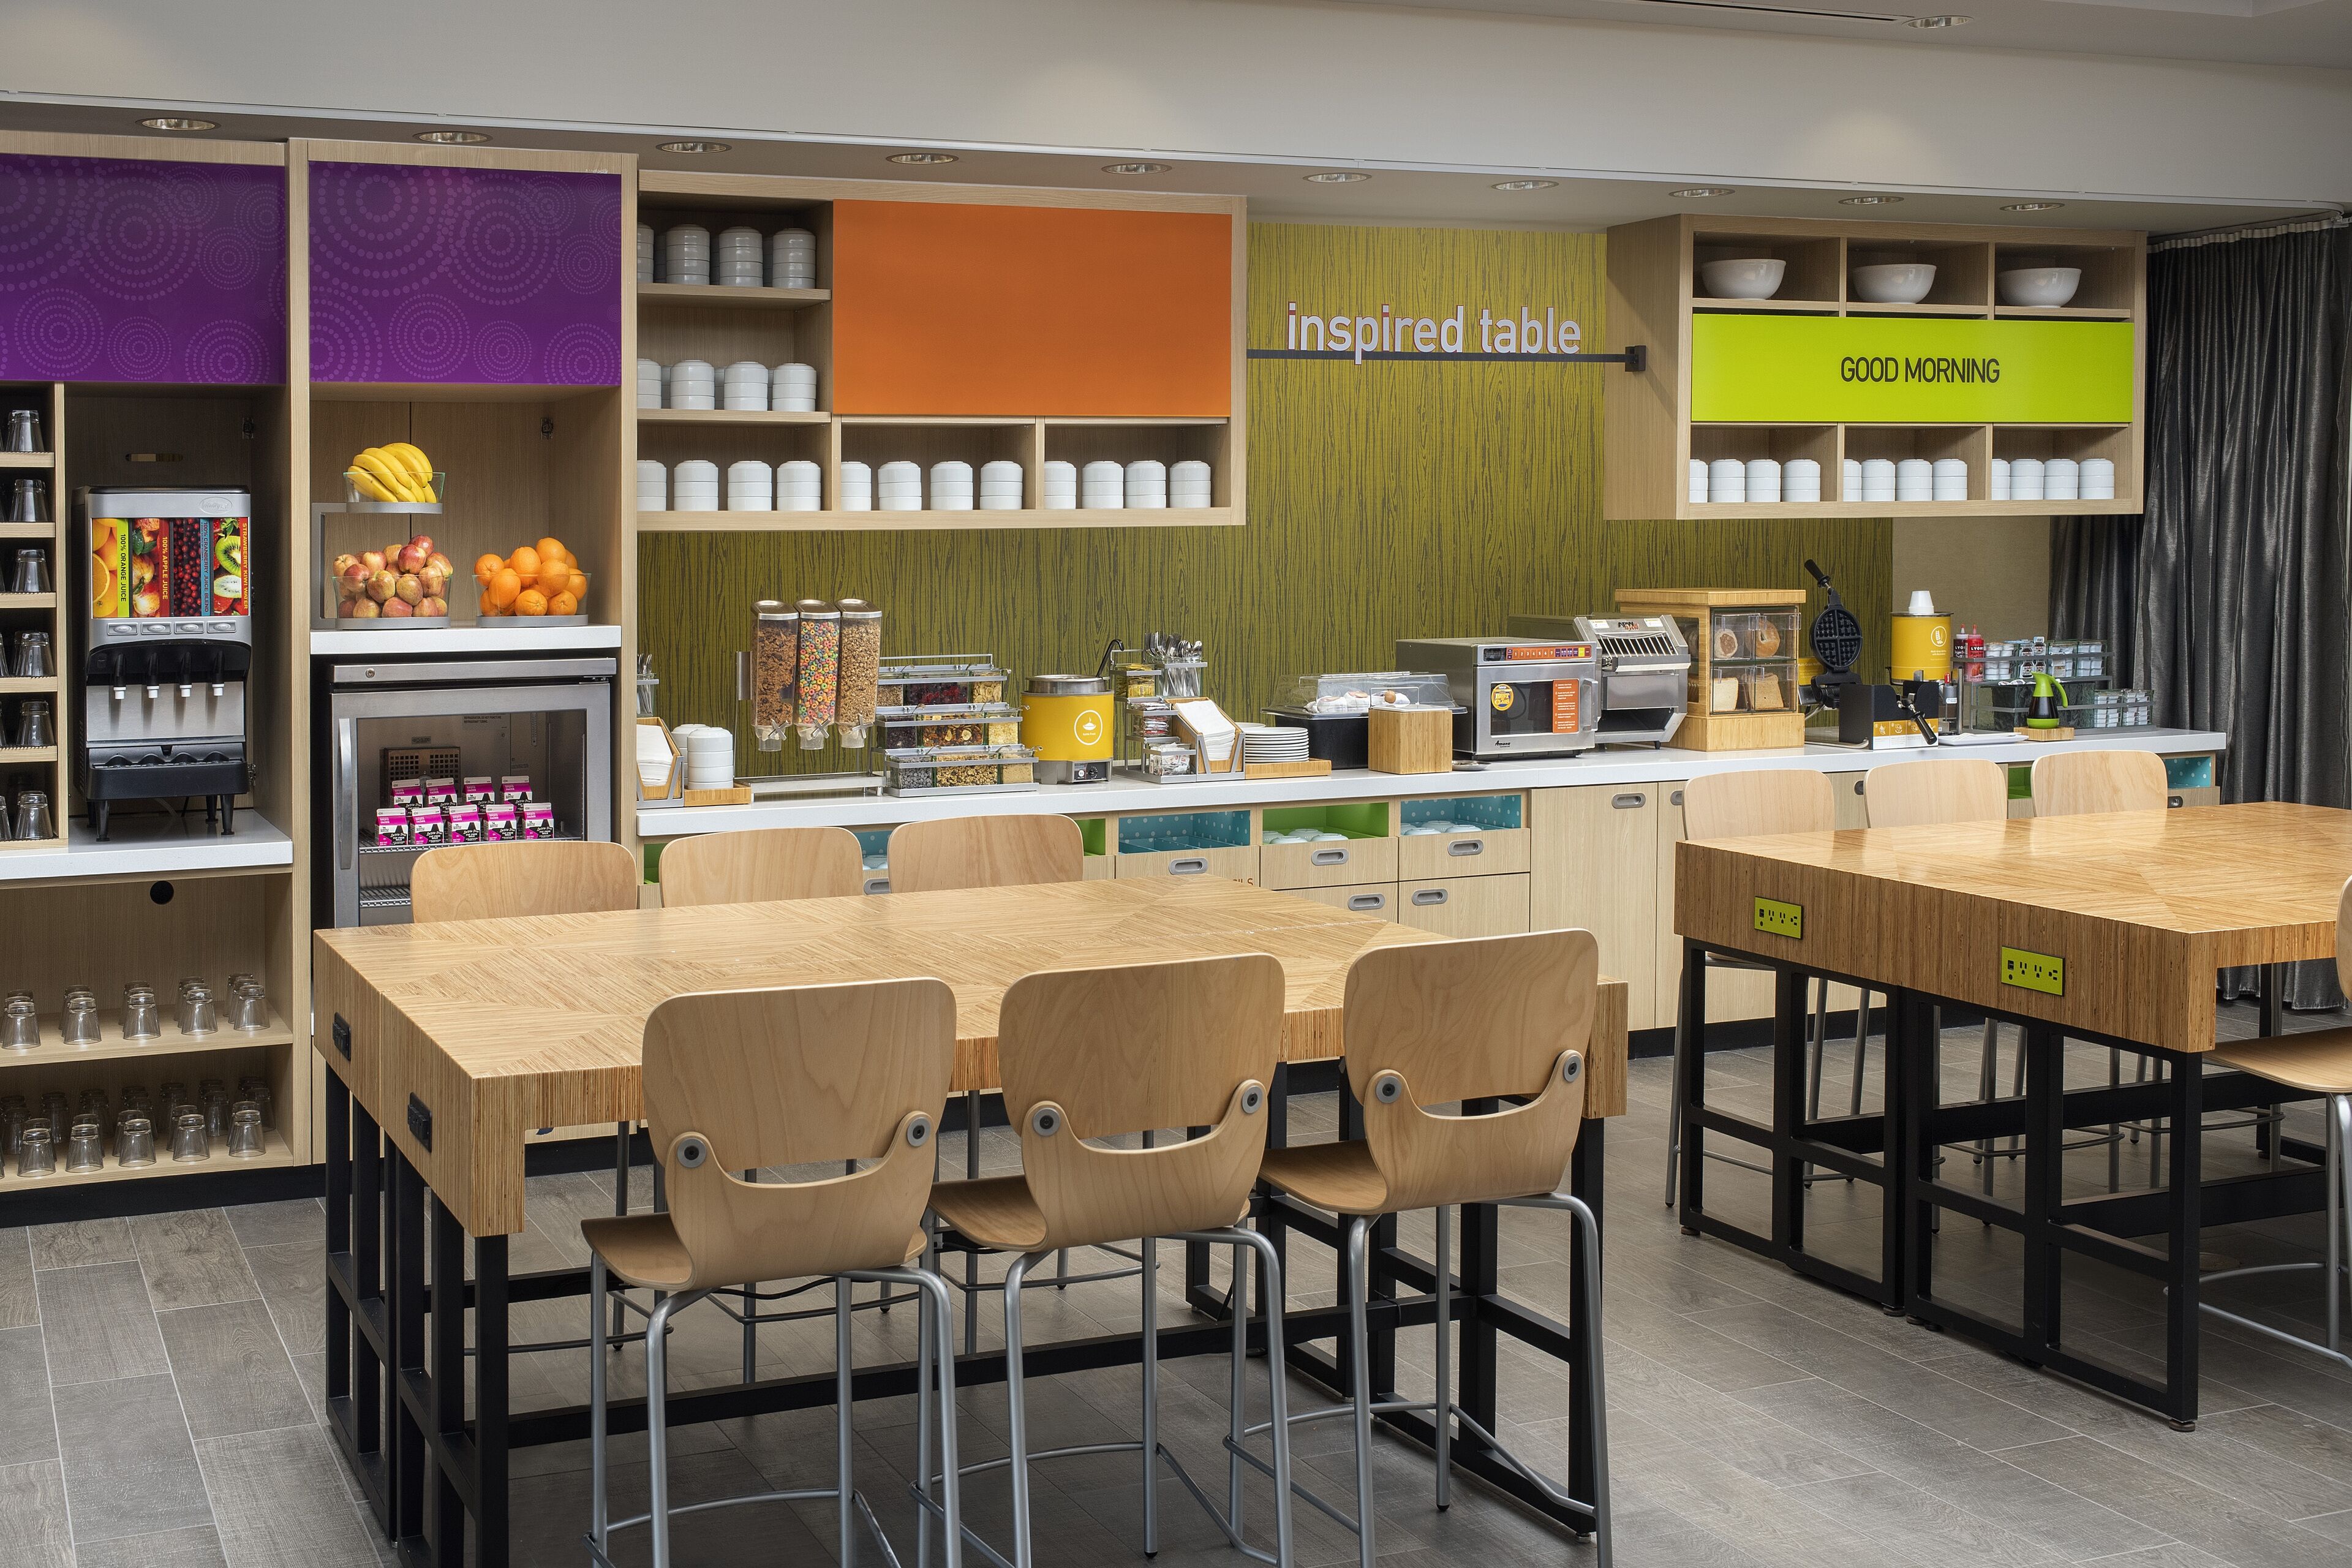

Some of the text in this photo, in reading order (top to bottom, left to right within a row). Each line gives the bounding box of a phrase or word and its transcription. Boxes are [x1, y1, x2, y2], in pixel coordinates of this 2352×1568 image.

[1288, 301, 1581, 365] inspired table
[1841, 356, 2000, 383] GOOD MORNING
